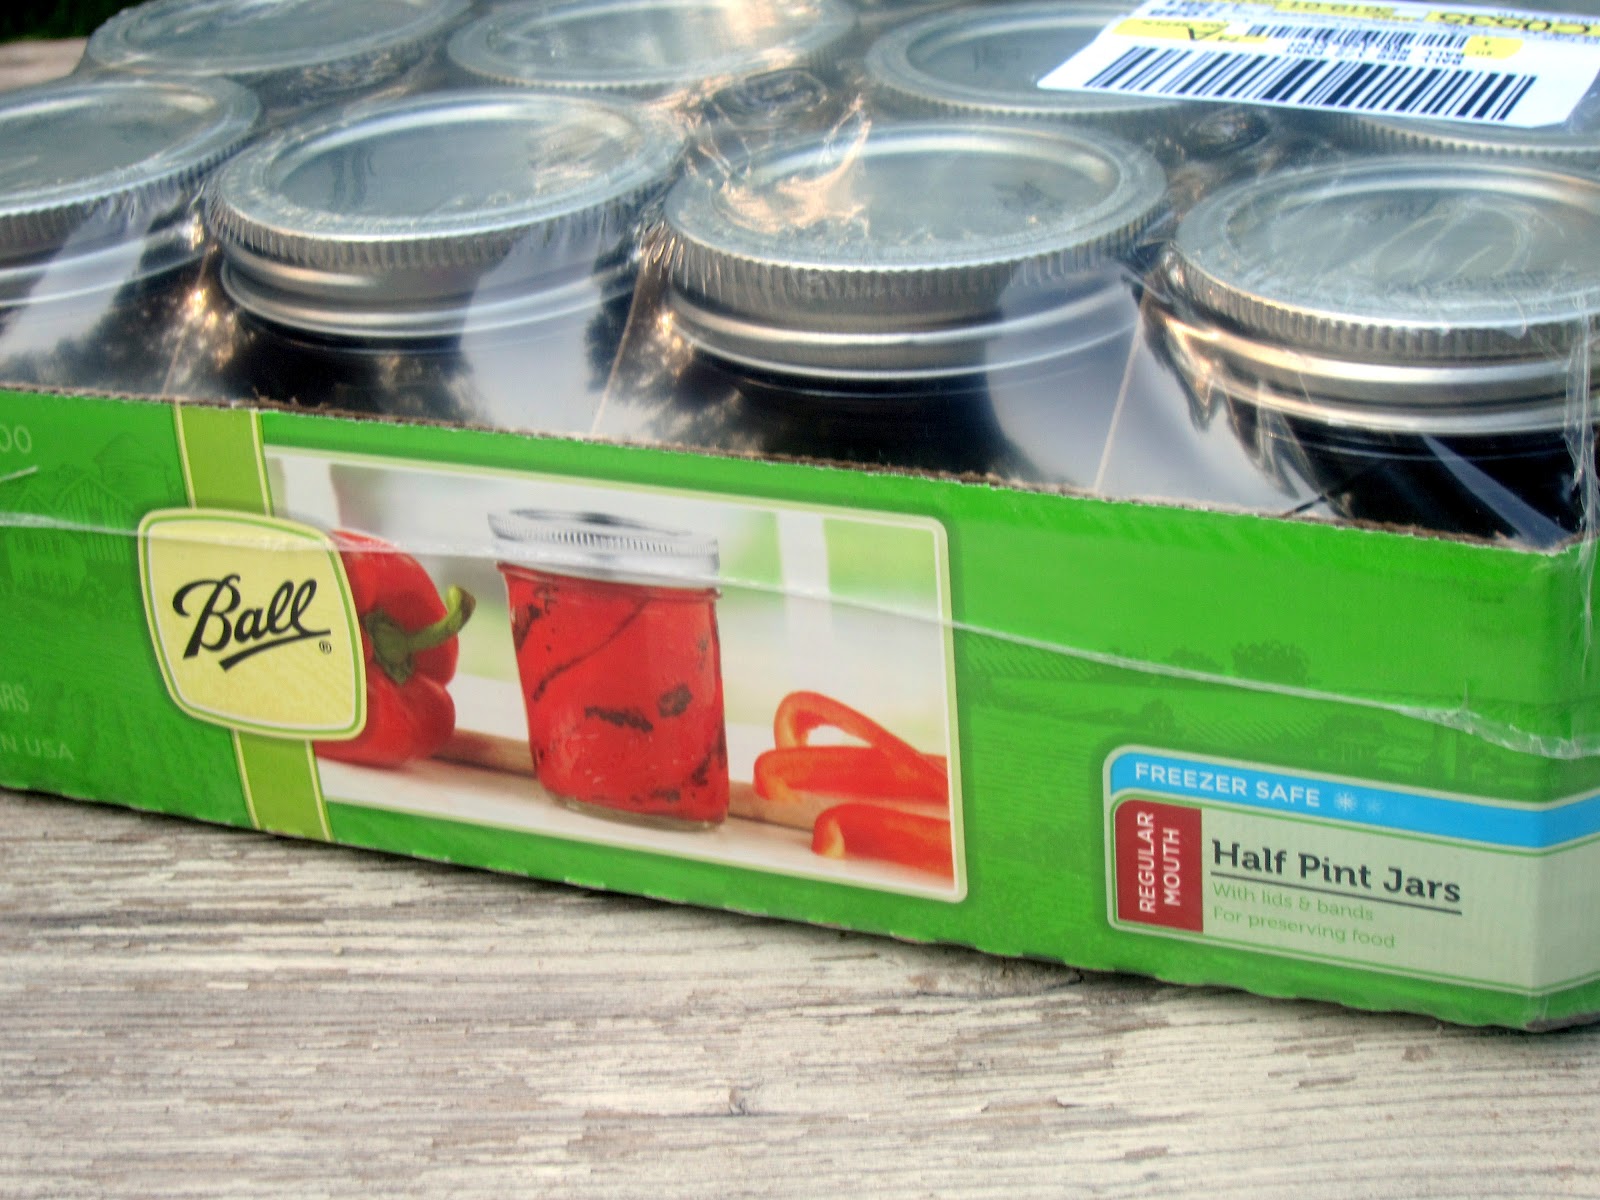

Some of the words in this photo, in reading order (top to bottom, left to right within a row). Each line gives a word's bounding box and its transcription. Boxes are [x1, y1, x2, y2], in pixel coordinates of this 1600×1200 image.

[172, 573, 332, 672] Ball
[0, 682, 29, 713] RS
[24, 735, 75, 761] USA
[1135, 763, 1247, 797] FREEZER
[1256, 781, 1320, 807] SAFE
[1137, 812, 1157, 913] REGULAR
[1162, 828, 1182, 906] MOUTH
[1211, 839, 1287, 874] Half
[1298, 853, 1372, 889] Pint
[1383, 867, 1461, 902] Jars
[1213, 881, 1256, 902] With
[1261, 888, 1293, 909] lids
[1316, 897, 1374, 920] bands
[1213, 907, 1242, 924] For
[1249, 913, 1346, 943] preserving
[1351, 922, 1396, 948] food
